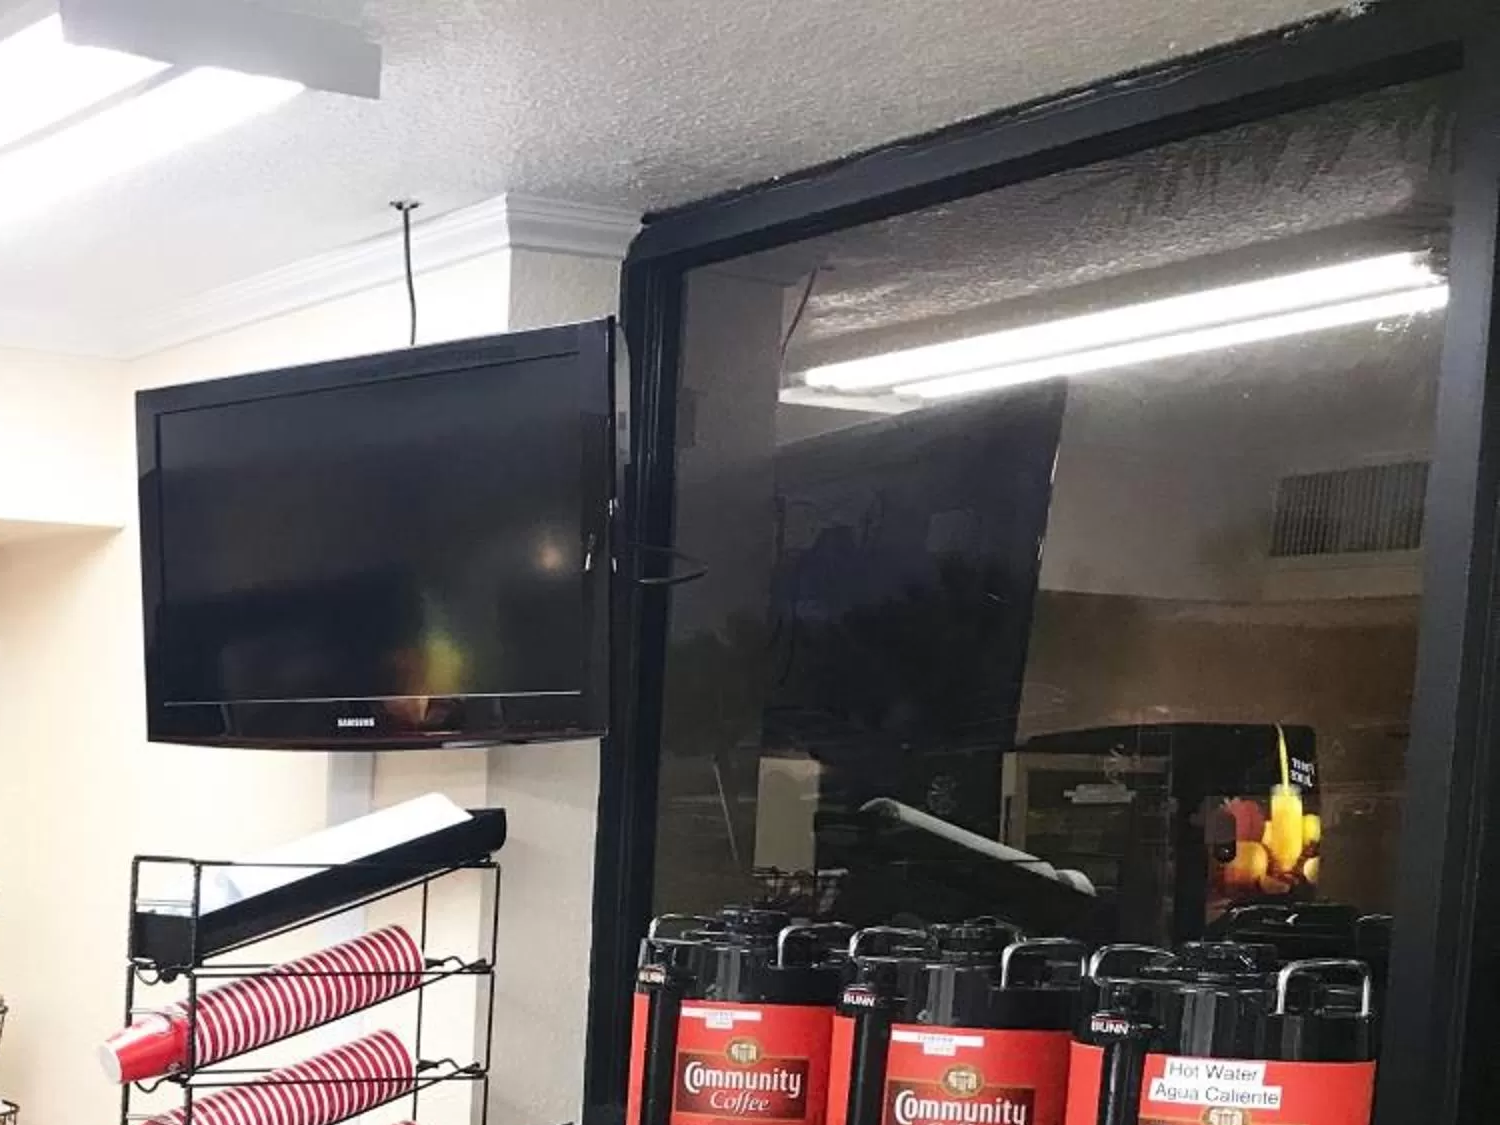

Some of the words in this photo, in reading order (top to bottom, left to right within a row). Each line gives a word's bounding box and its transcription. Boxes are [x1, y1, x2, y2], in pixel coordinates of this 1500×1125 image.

[843, 993, 876, 1007] BUNN
[1091, 1018, 1130, 1035] BUNN
[684, 1061, 802, 1099] Community
[1168, 1062, 1200, 1080] Hot
[1204, 1065, 1258, 1081] Water
[710, 1090, 771, 1113] Coffee
[1155, 1084, 1199, 1103] Agua
[1205, 1086, 1279, 1106] Caliente
